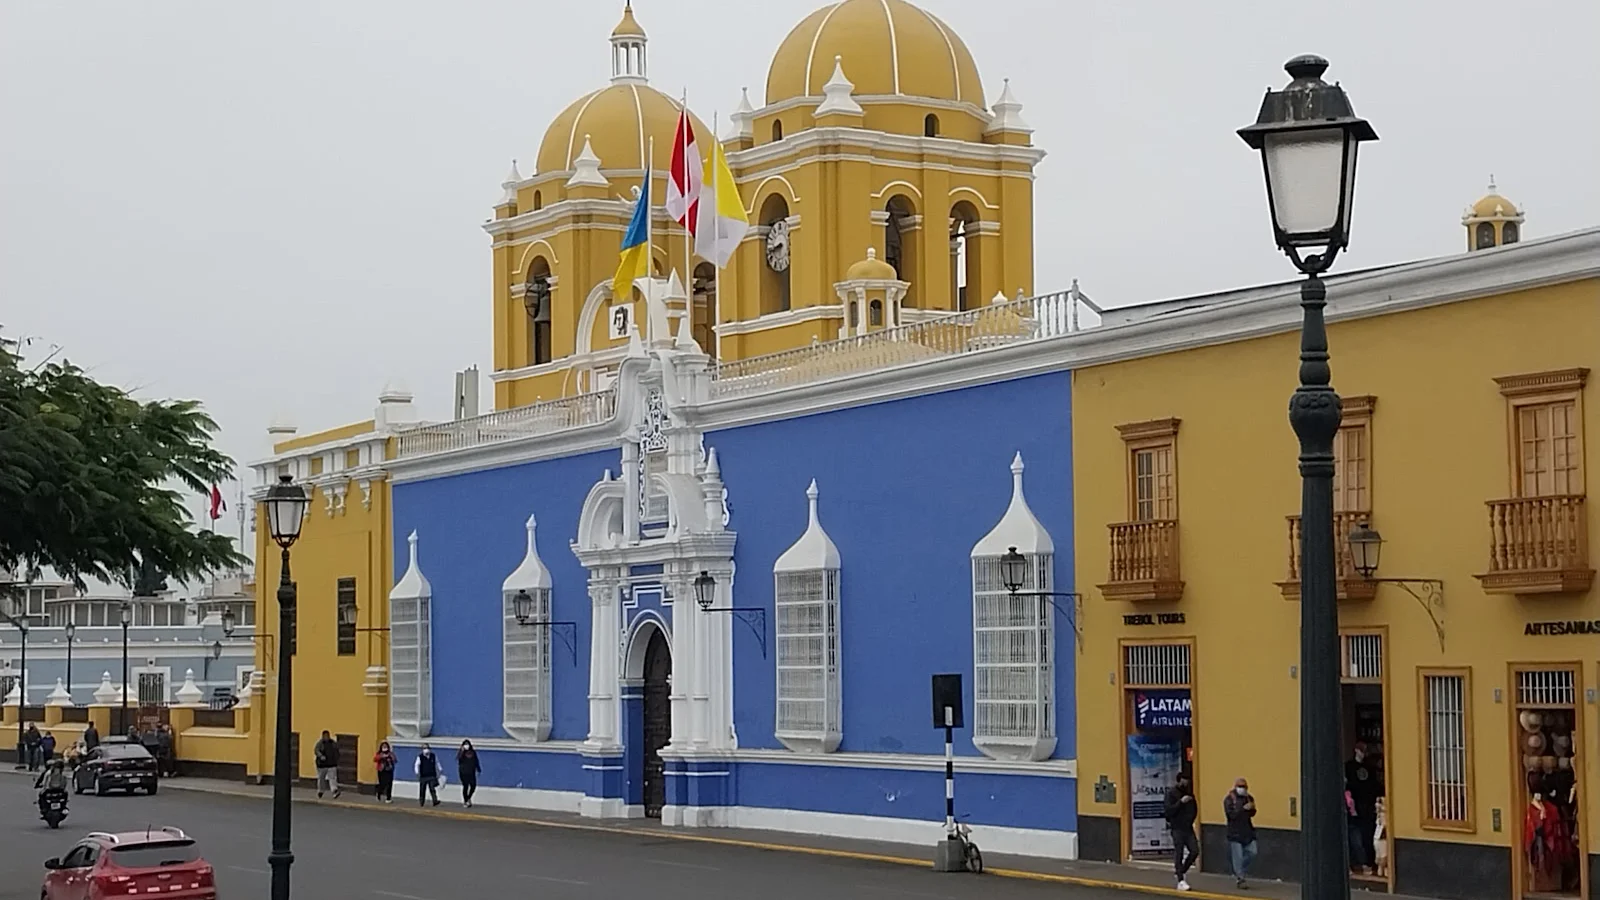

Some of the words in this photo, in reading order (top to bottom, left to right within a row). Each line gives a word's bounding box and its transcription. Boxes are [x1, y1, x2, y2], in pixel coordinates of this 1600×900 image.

[1156, 613, 1186, 624] TOURS
[1524, 620, 1600, 635] ARTESANIAS
[1151, 698, 1192, 711] LATAM
